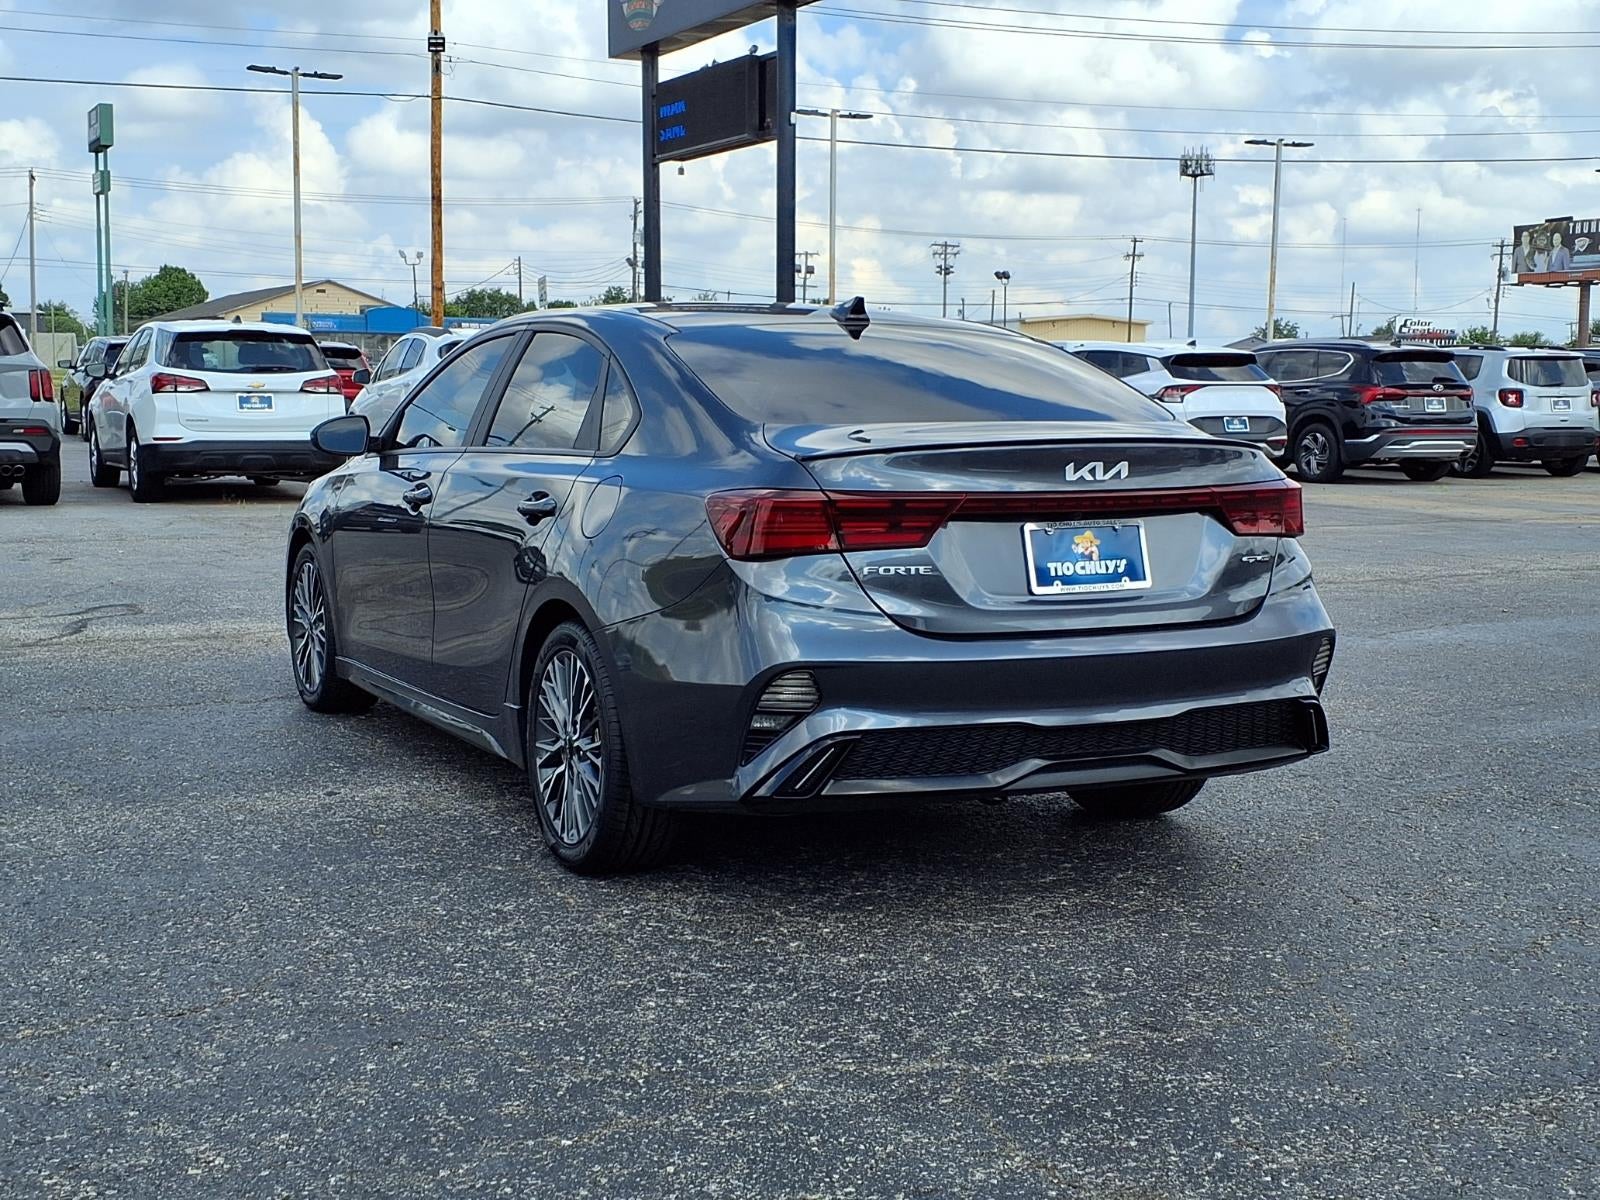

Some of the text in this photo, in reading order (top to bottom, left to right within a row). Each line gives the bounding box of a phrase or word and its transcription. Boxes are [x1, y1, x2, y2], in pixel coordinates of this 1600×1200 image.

[1568, 220, 1600, 235] THUN
[1403, 318, 1433, 328] Color
[1398, 324, 1456, 335] Creations
[1065, 461, 1129, 481] KIA
[863, 565, 932, 575] FORTE
